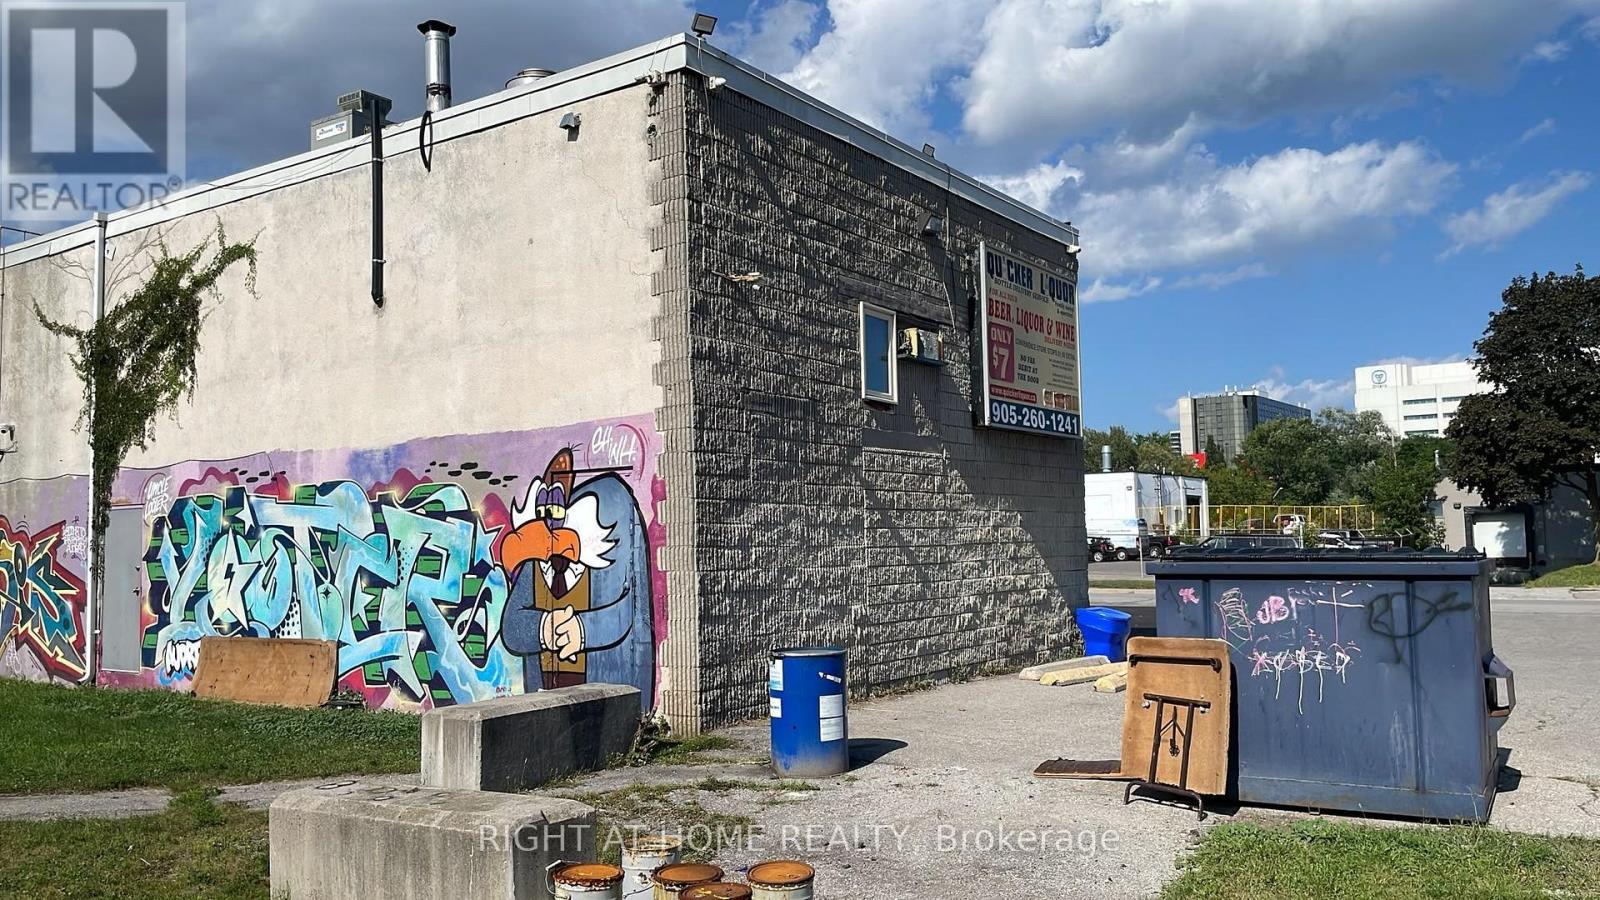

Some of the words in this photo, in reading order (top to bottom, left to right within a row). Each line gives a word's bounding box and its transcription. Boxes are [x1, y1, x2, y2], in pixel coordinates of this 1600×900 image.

[987, 252, 1033, 290] QUCKER
[1041, 273, 1075, 305] LQUOR
[991, 328, 1012, 344] ONLY
[1016, 308, 1044, 333] LIQUOR
[1046, 318, 1053, 335] &
[1056, 321, 1075, 341] WINE
[993, 344, 1009, 380] $7
[992, 402, 1078, 434] 905-260-1241
